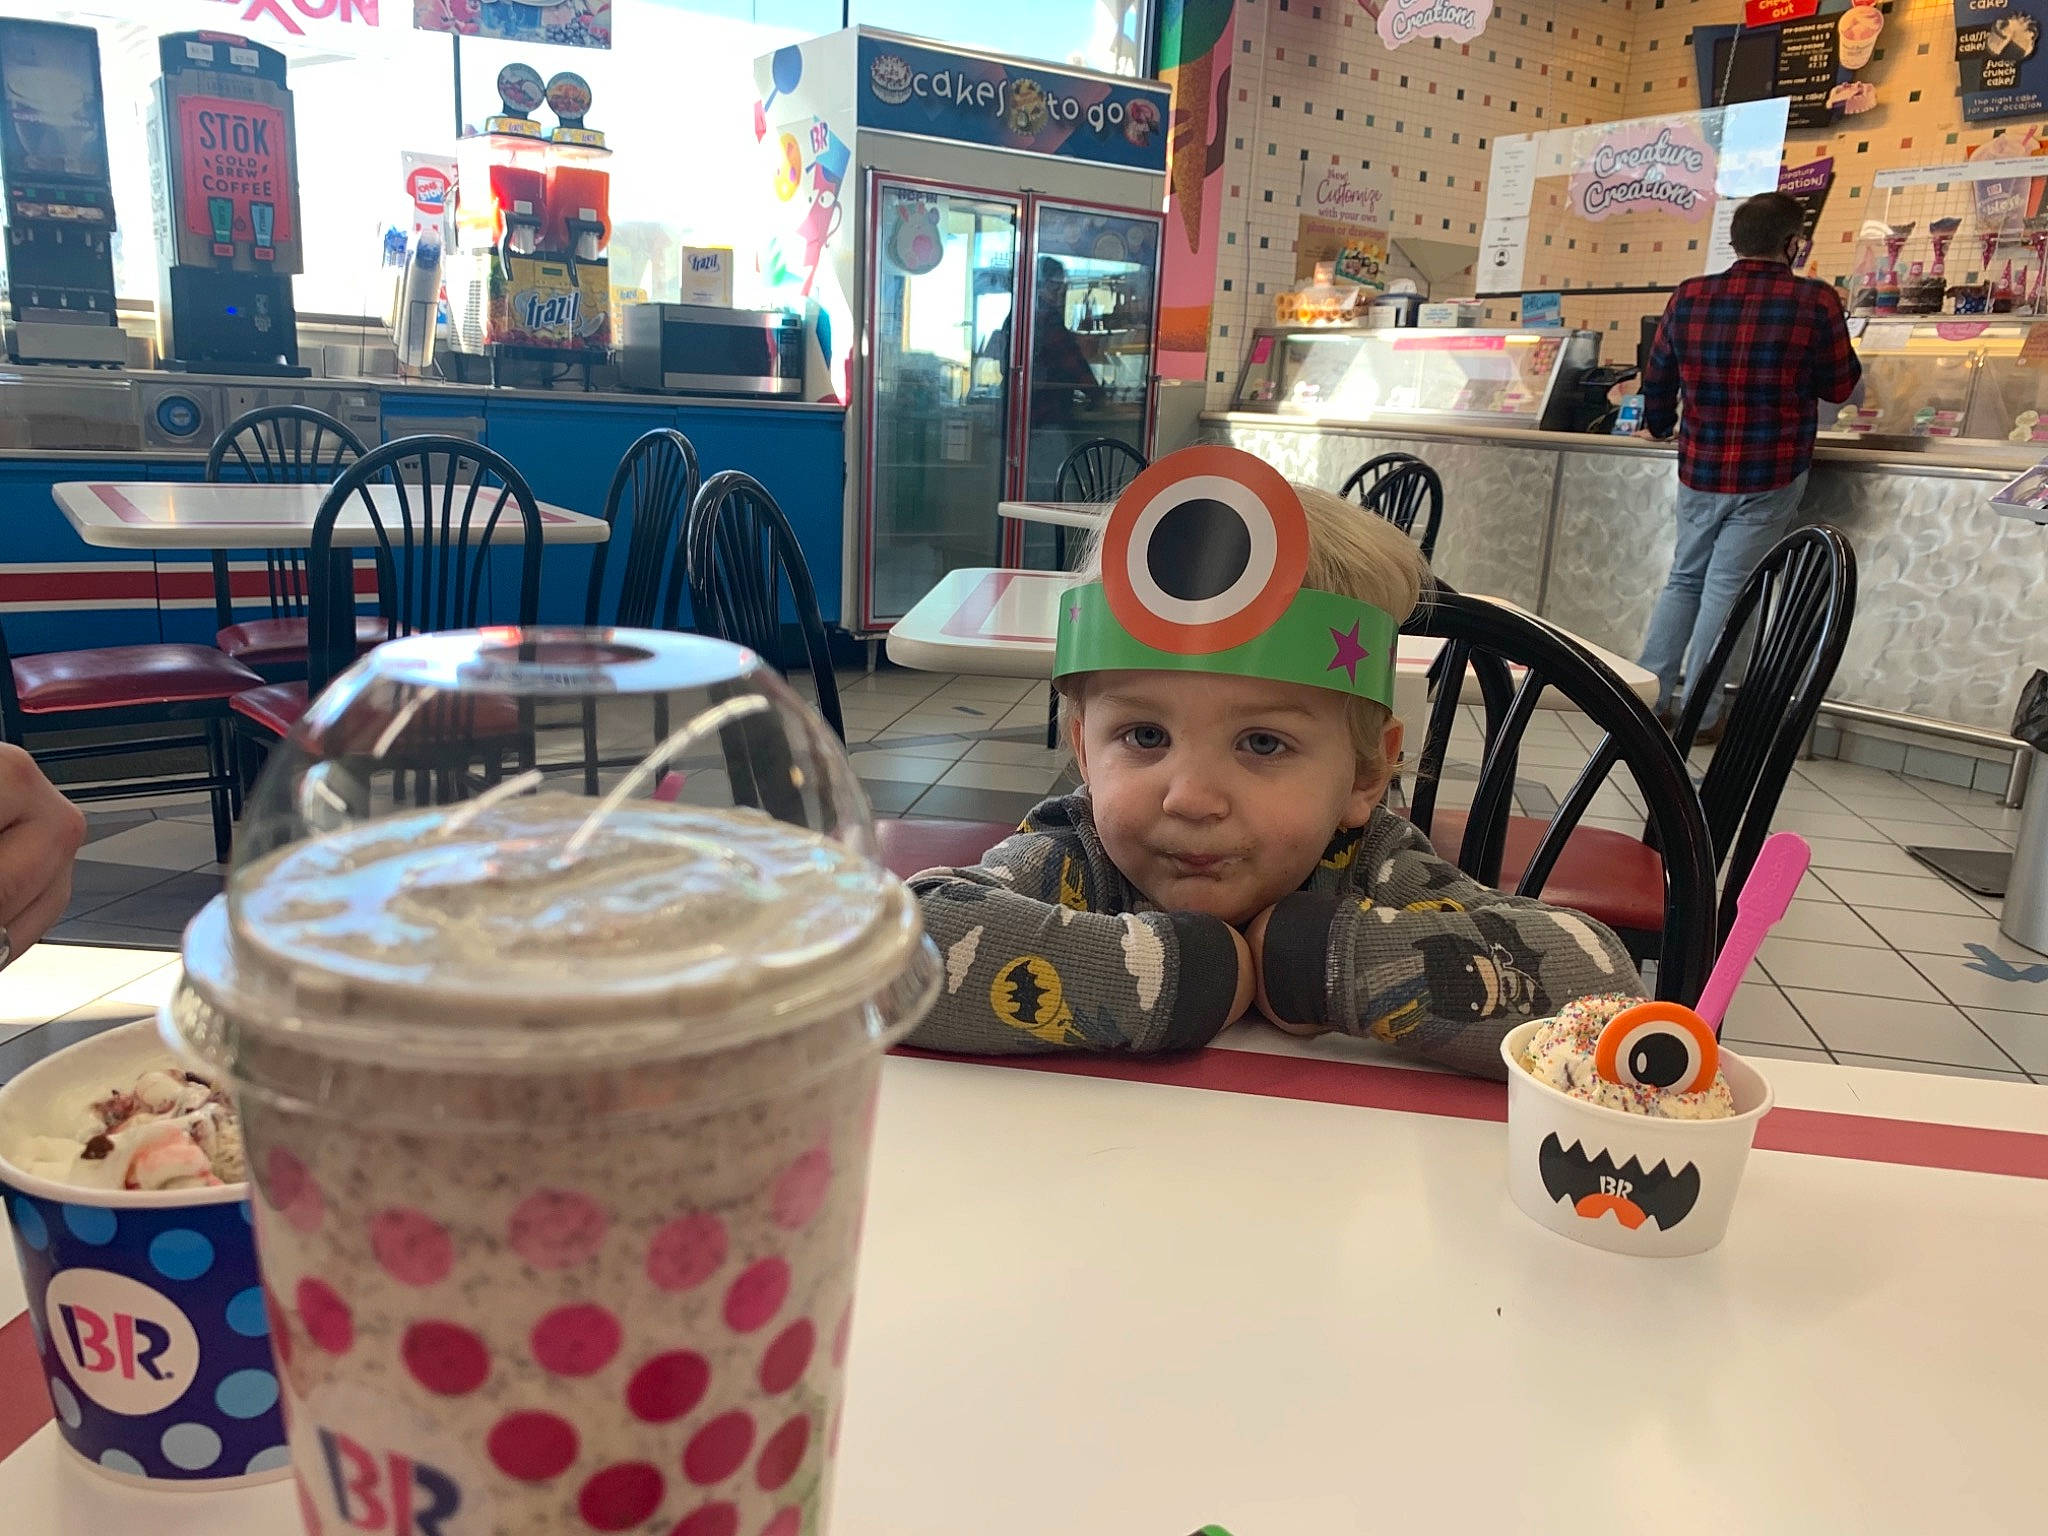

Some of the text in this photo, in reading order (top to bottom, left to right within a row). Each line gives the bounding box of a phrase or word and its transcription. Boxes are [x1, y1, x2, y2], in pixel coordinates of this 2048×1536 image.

[1392, 0, 1475, 40] Creations
[912, 68, 1124, 133] cakes to go
[215, 154, 258, 169] COLD
[1594, 128, 1703, 179] Creature
[202, 174, 272, 197] COFFEE
[216, 166, 258, 178] BREW
[1316, 179, 1384, 213] Customize
[1584, 176, 1698, 214] Creations
[1318, 207, 1378, 223] with your own
[690, 253, 718, 272] frazil
[525, 291, 582, 330] frazil
[1600, 1175, 1633, 1200] BR
[58, 1303, 172, 1382] BR
[317, 1425, 463, 1536] BR
